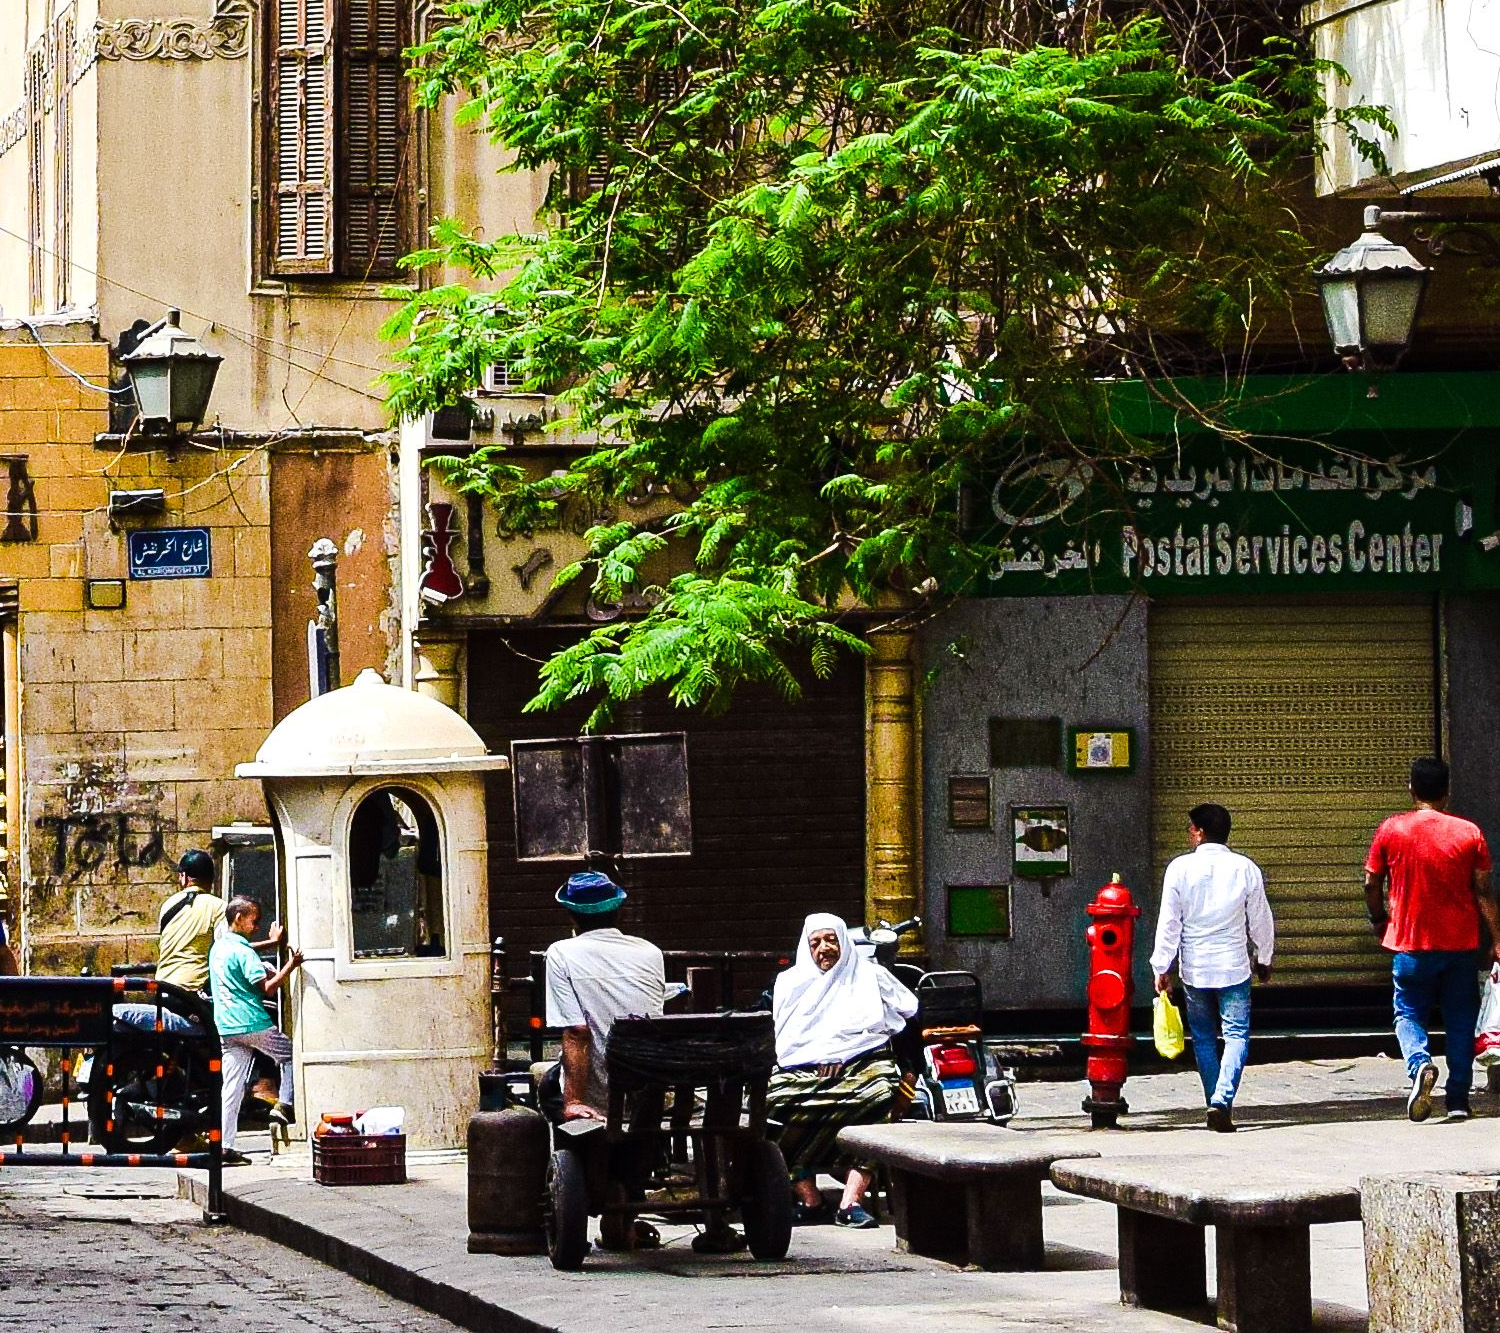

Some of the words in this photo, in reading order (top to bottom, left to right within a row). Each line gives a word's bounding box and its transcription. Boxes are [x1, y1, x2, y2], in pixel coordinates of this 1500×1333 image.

[182, 539, 203, 561] شارع
[1122, 522, 1210, 577] Postal
[1215, 521, 1343, 576] Services
[1347, 519, 1444, 574] Center
